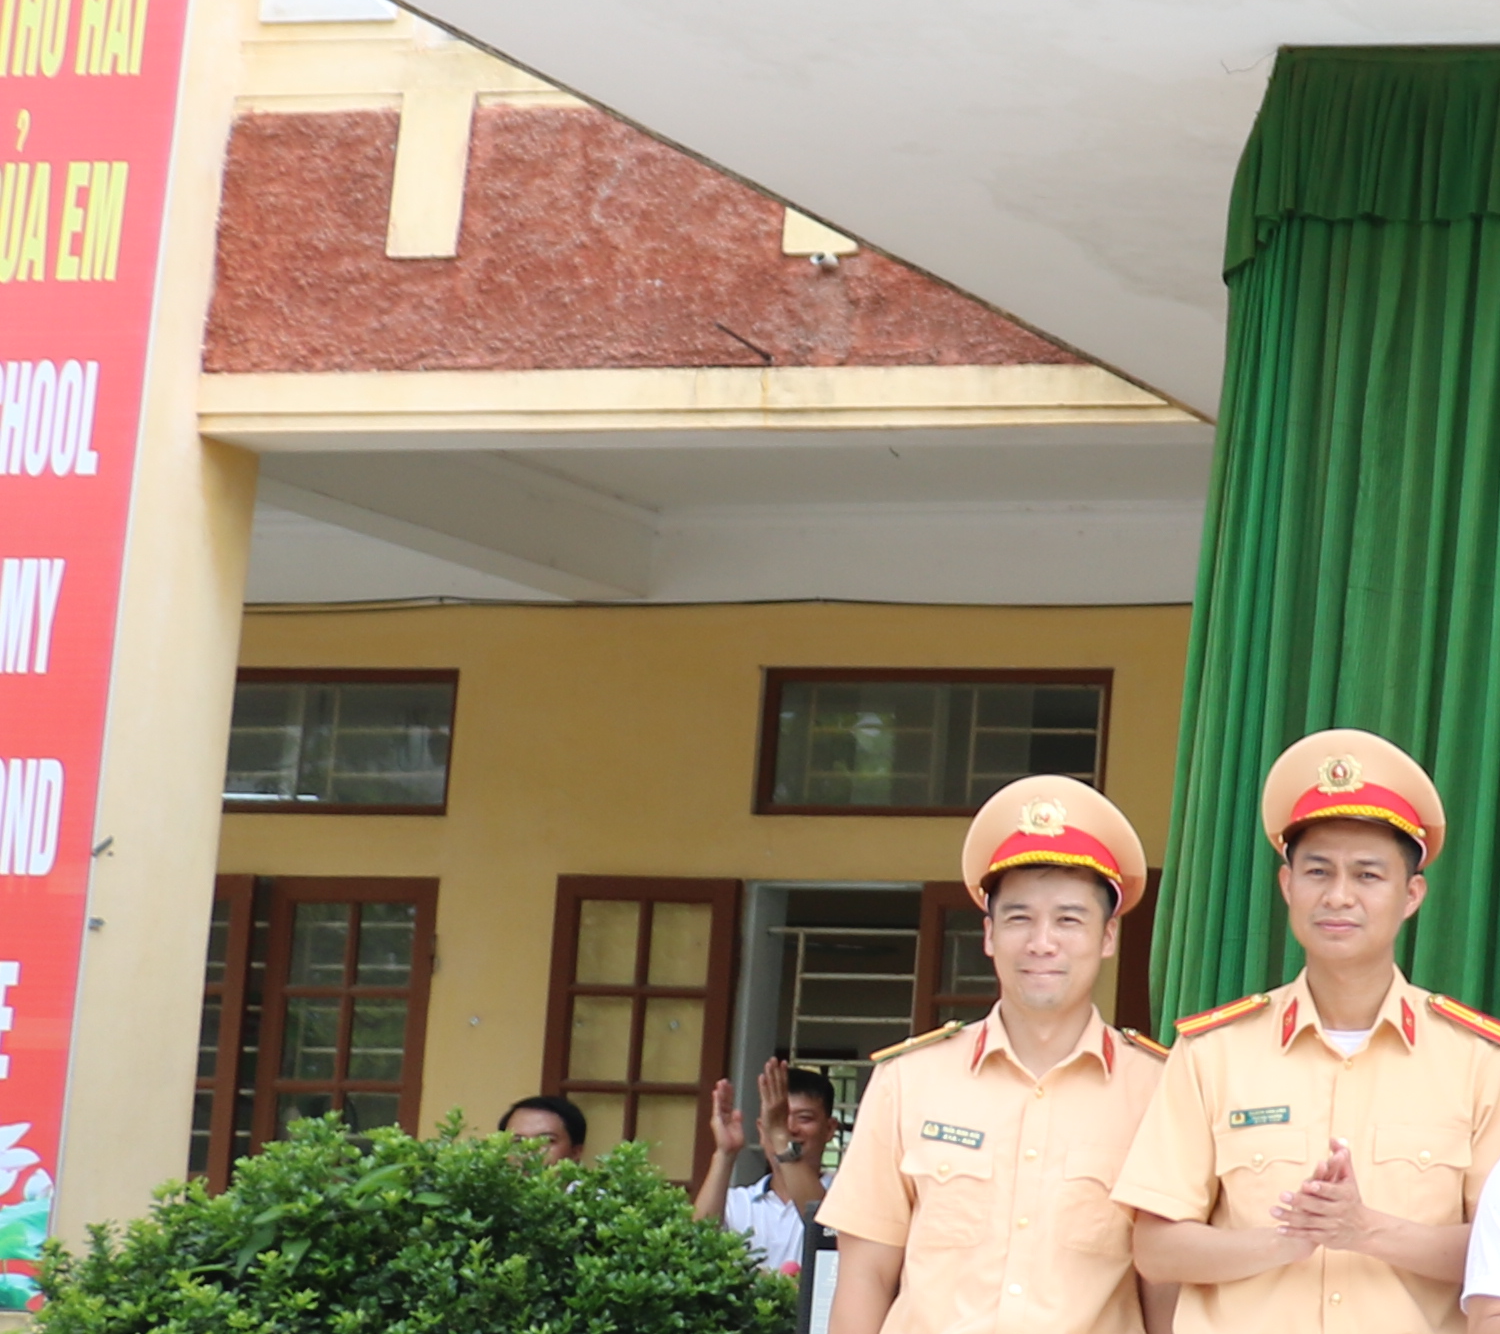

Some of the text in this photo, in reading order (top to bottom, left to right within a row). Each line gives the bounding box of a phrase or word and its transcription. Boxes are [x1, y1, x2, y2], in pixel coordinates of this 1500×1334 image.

[0, 108, 129, 284] ỦA EM
[0, 358, 99, 477] HOOL
[0, 557, 66, 675] MY
